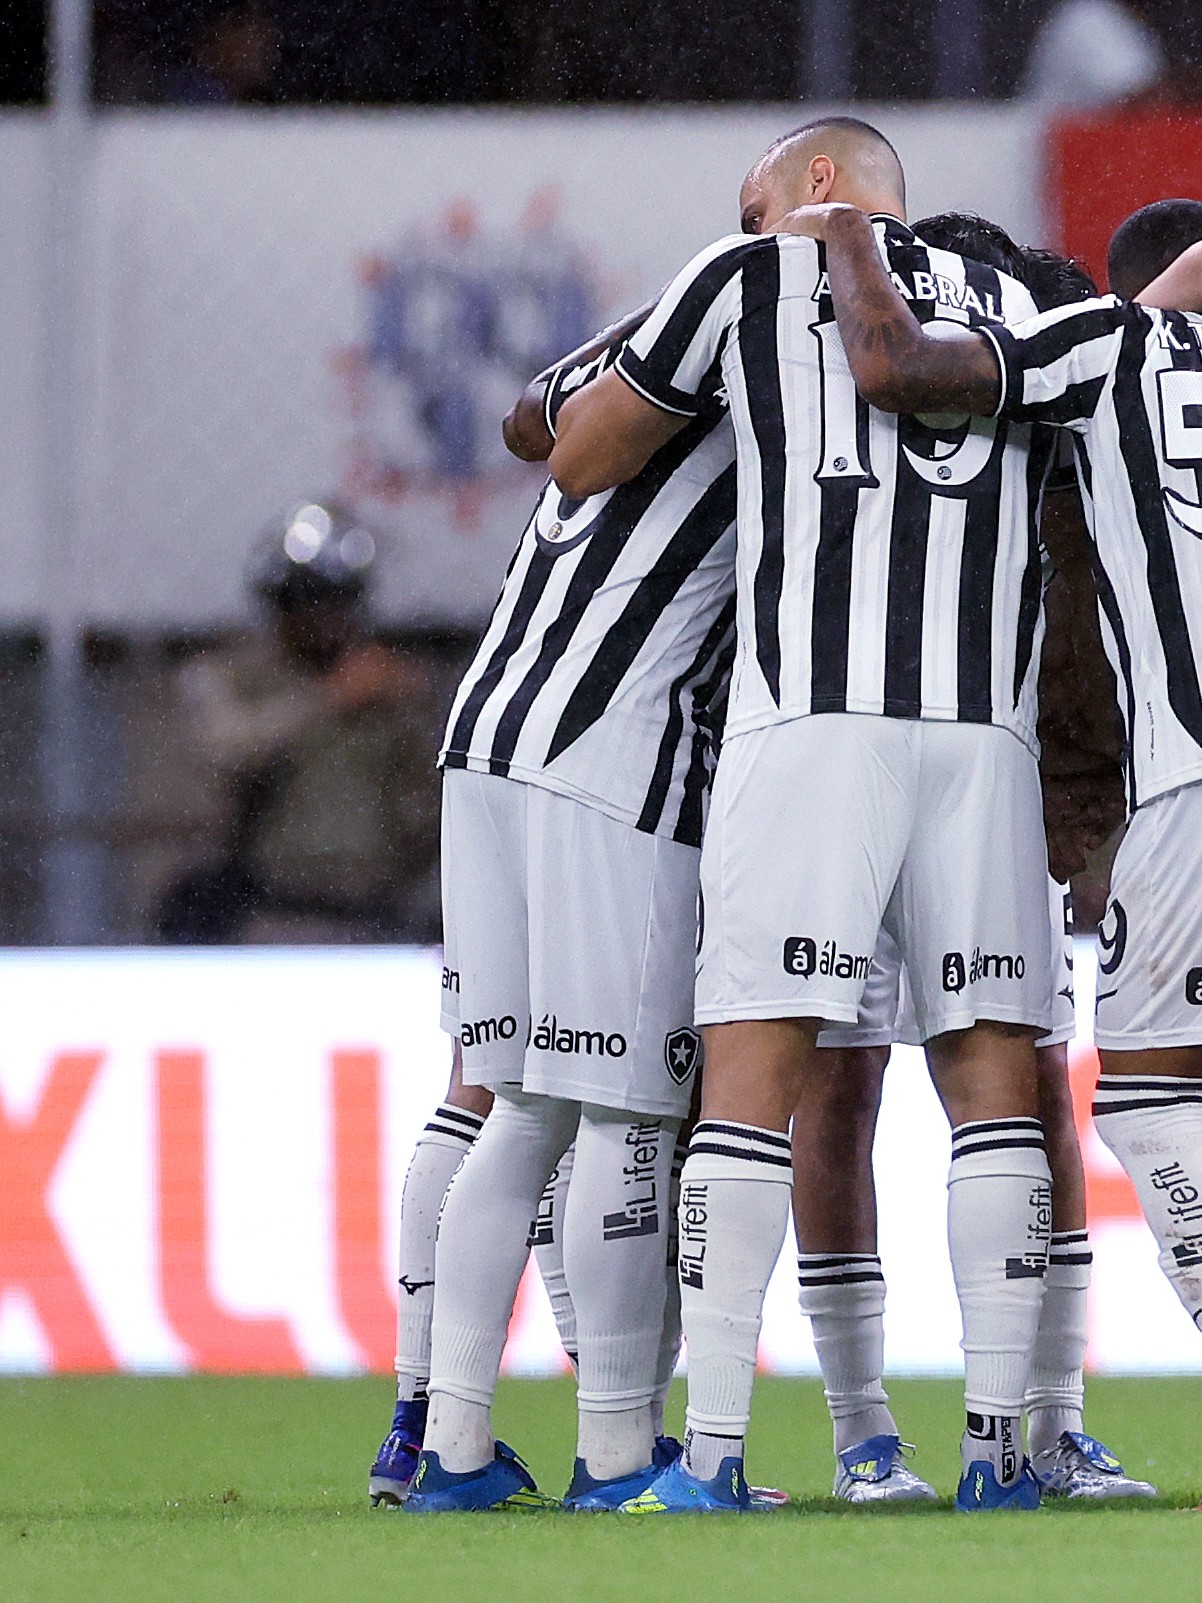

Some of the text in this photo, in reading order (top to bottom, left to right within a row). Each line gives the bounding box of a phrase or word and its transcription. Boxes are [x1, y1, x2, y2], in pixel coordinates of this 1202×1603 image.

[811, 271, 1005, 325] A ABRAL
[1158, 320, 1191, 350] K.
[820, 940, 872, 980] álam
[461, 1015, 517, 1047] amo
[533, 1013, 627, 1058] álamo
[681, 1185, 708, 1262] Lifefit
